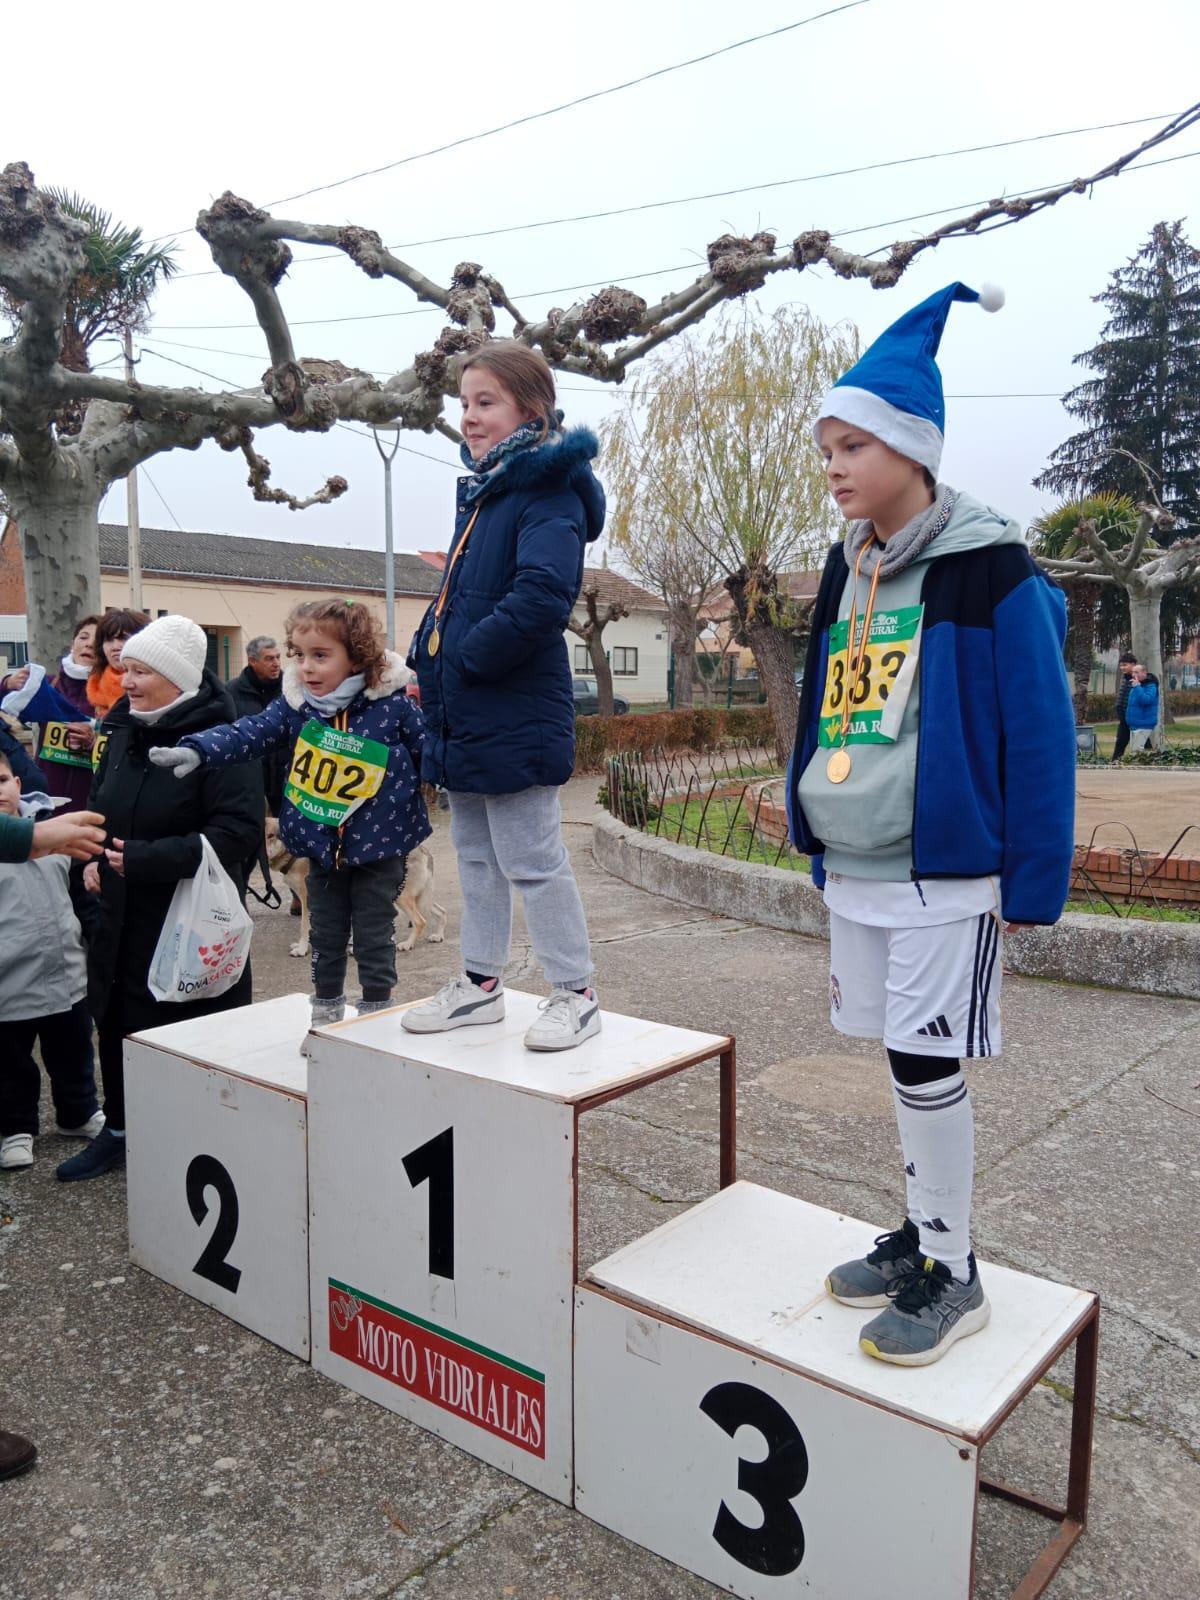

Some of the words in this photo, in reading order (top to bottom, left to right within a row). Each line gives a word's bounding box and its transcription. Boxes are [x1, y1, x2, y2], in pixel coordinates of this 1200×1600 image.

[293, 749, 366, 801] 402
[185, 1154, 242, 1295] 2
[402, 1125, 455, 1281] 1
[356, 1314, 417, 1385] MOTO
[423, 1347, 542, 1449] VIDRIALES
[699, 1381, 809, 1577] 3
